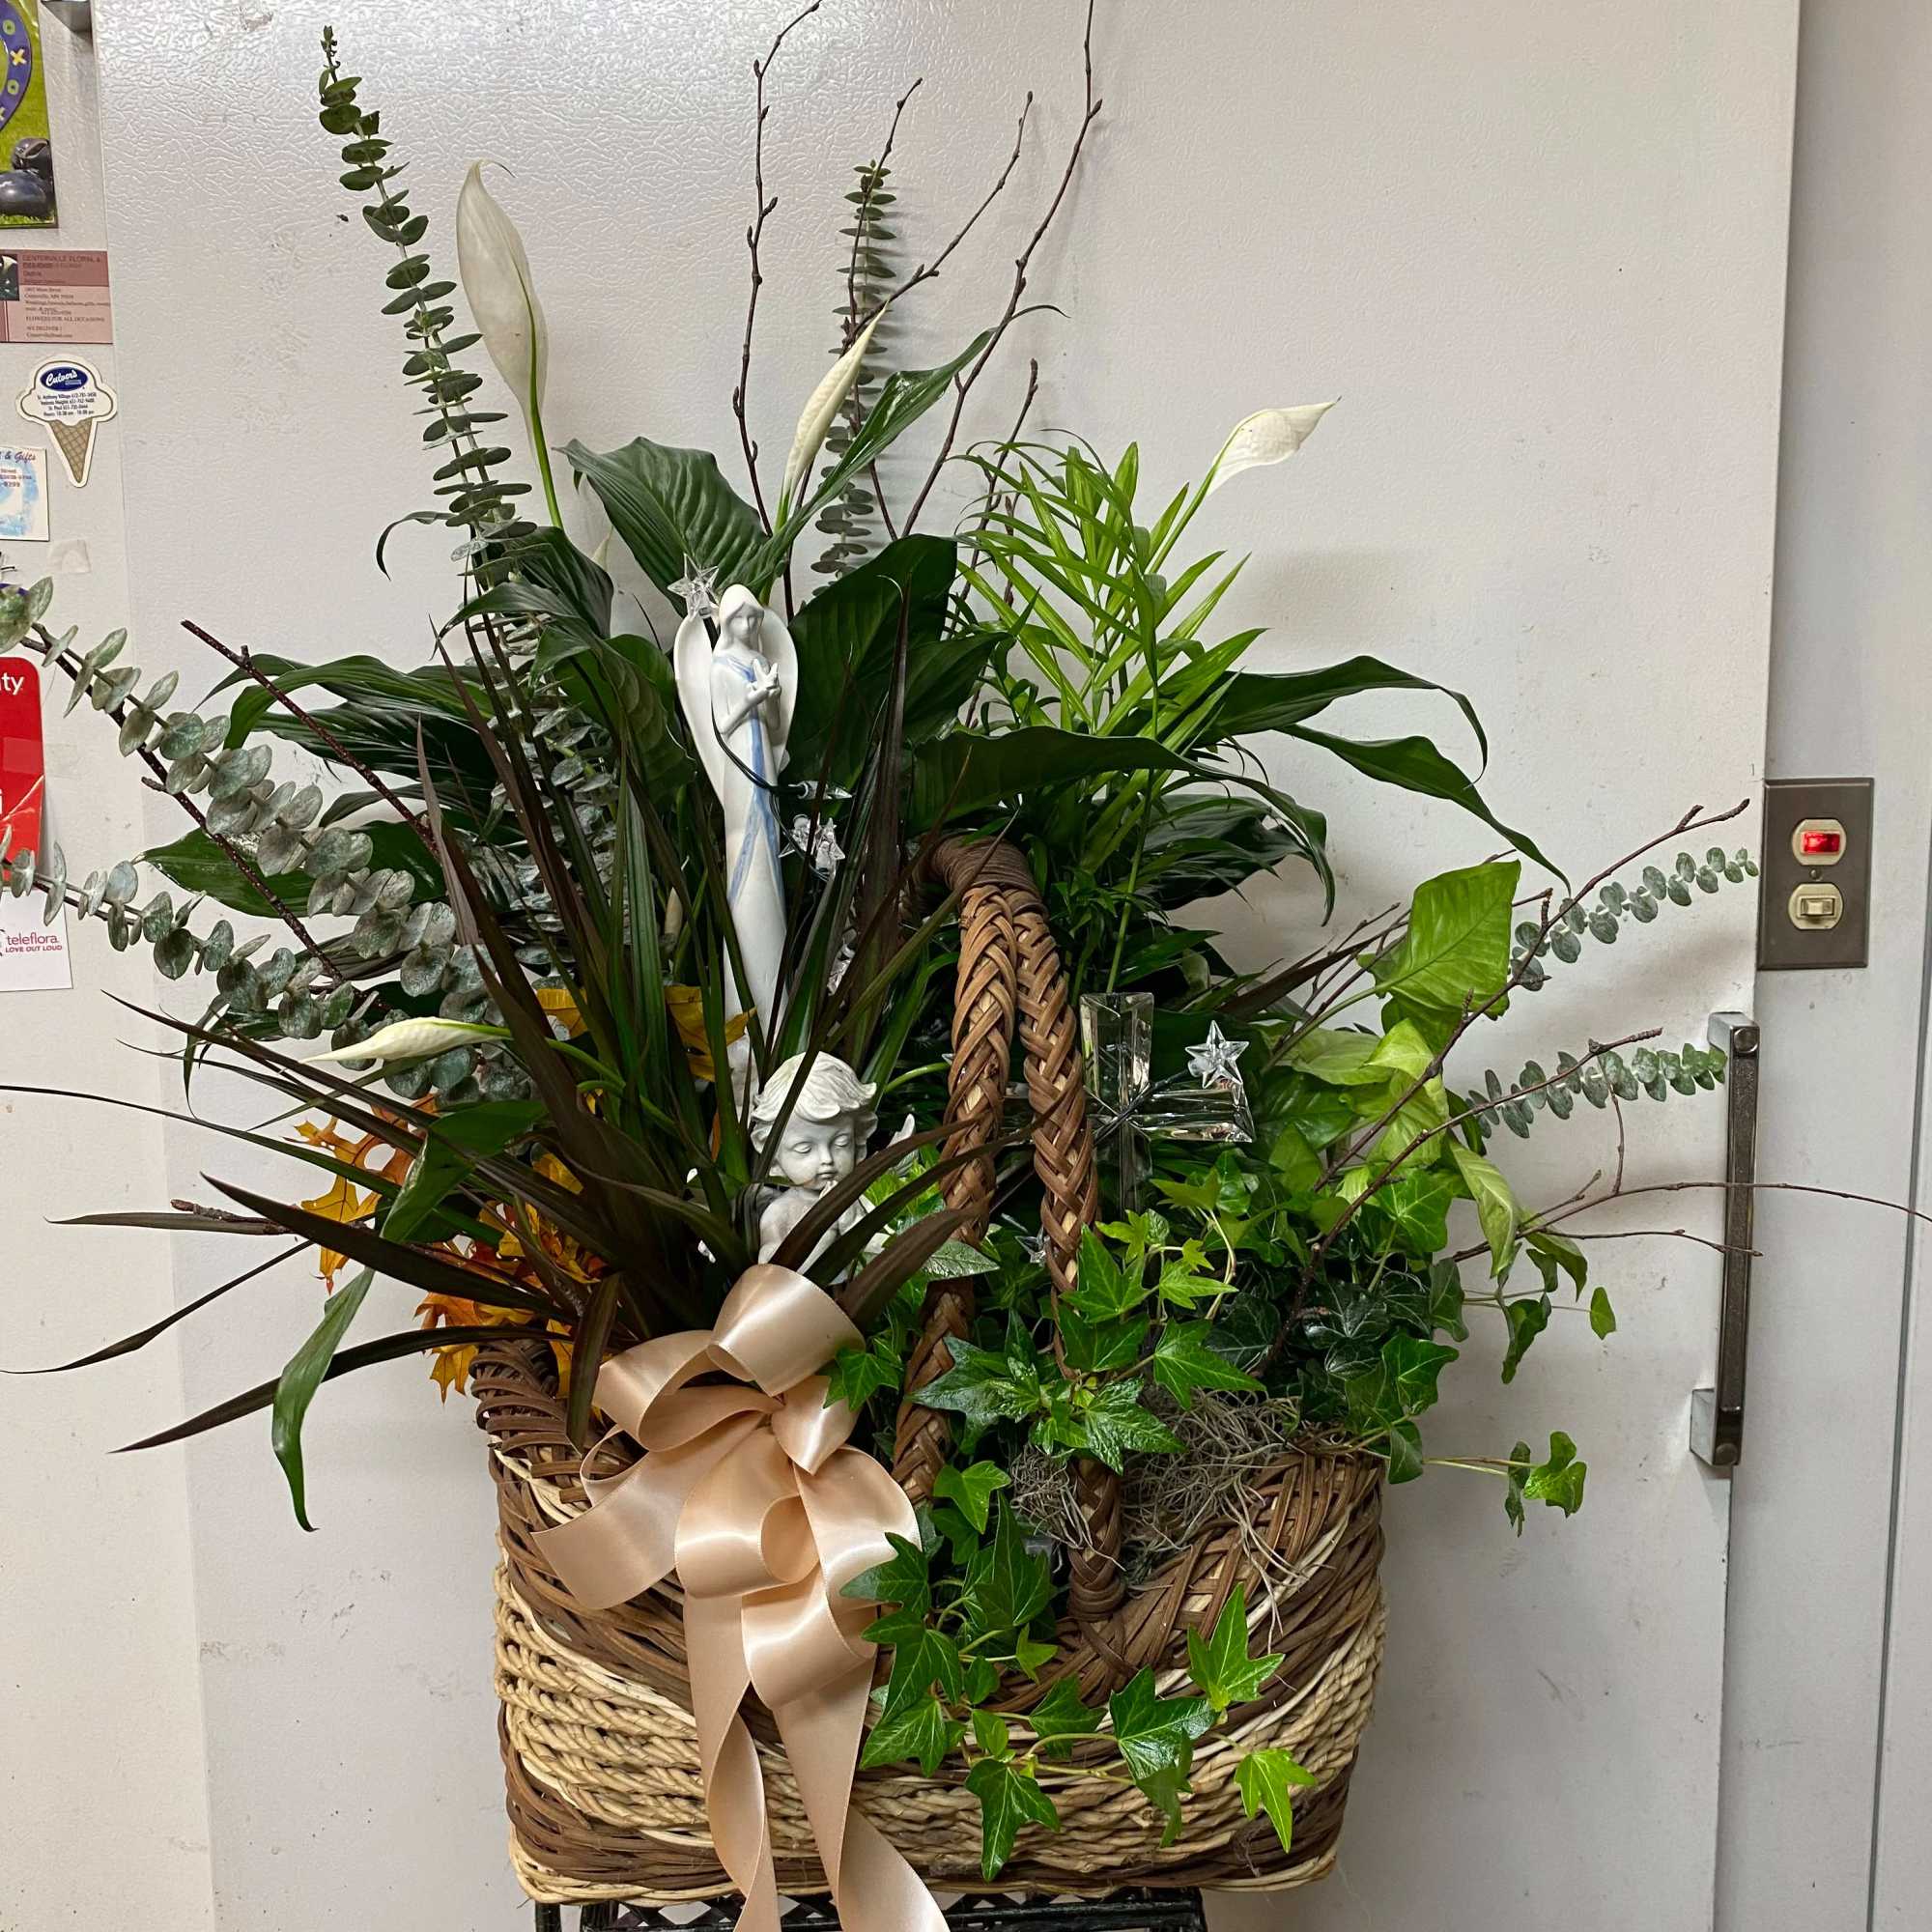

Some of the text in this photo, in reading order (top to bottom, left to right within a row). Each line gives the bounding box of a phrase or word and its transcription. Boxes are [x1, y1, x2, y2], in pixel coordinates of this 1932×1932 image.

[45, 369, 77, 386] Culver's
[14, 451, 36, 464] Gifts
[7, 932, 58, 946] teleflora
